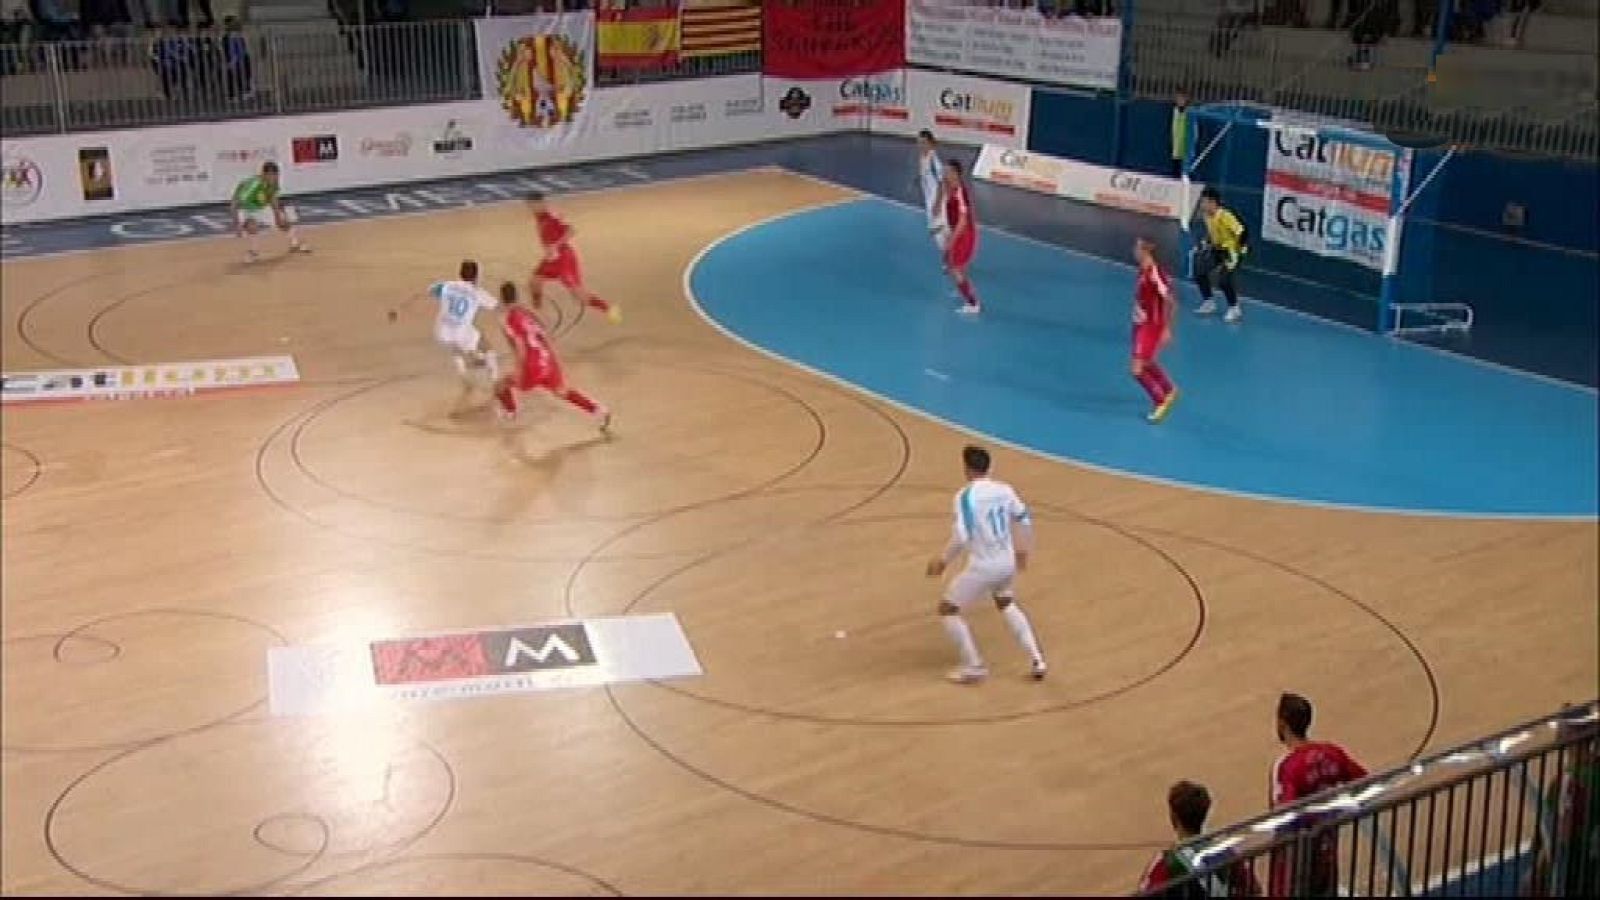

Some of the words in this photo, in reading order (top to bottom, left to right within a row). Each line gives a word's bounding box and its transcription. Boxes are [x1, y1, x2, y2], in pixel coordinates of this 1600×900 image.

[1276, 195, 1389, 251] Catgas
[447, 296, 470, 316] 10
[986, 506, 1006, 535] 11
